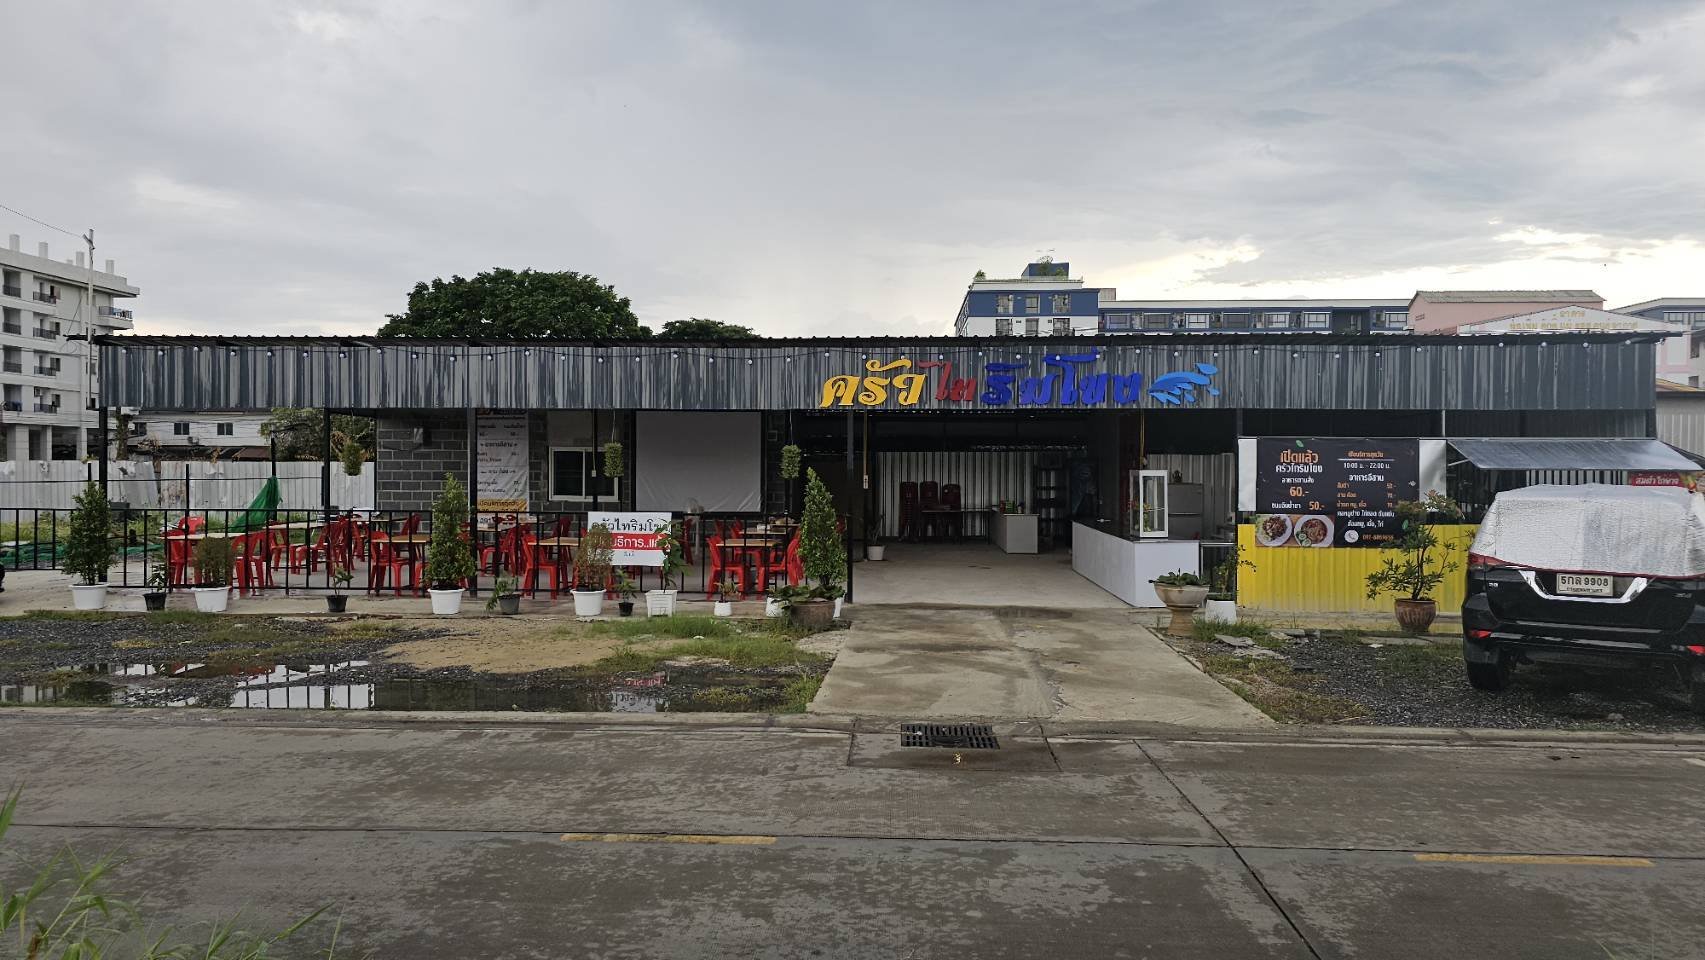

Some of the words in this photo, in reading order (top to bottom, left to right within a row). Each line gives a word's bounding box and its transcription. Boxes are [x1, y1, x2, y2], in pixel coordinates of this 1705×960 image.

[1280, 449, 1319, 463] เปิดแล้ว
[1289, 486, 1310, 497] 60.-
[1308, 501, 1325, 511] 50.-
[1560, 575, 1582, 586] 5กล
[1583, 576, 1609, 587] 9908
